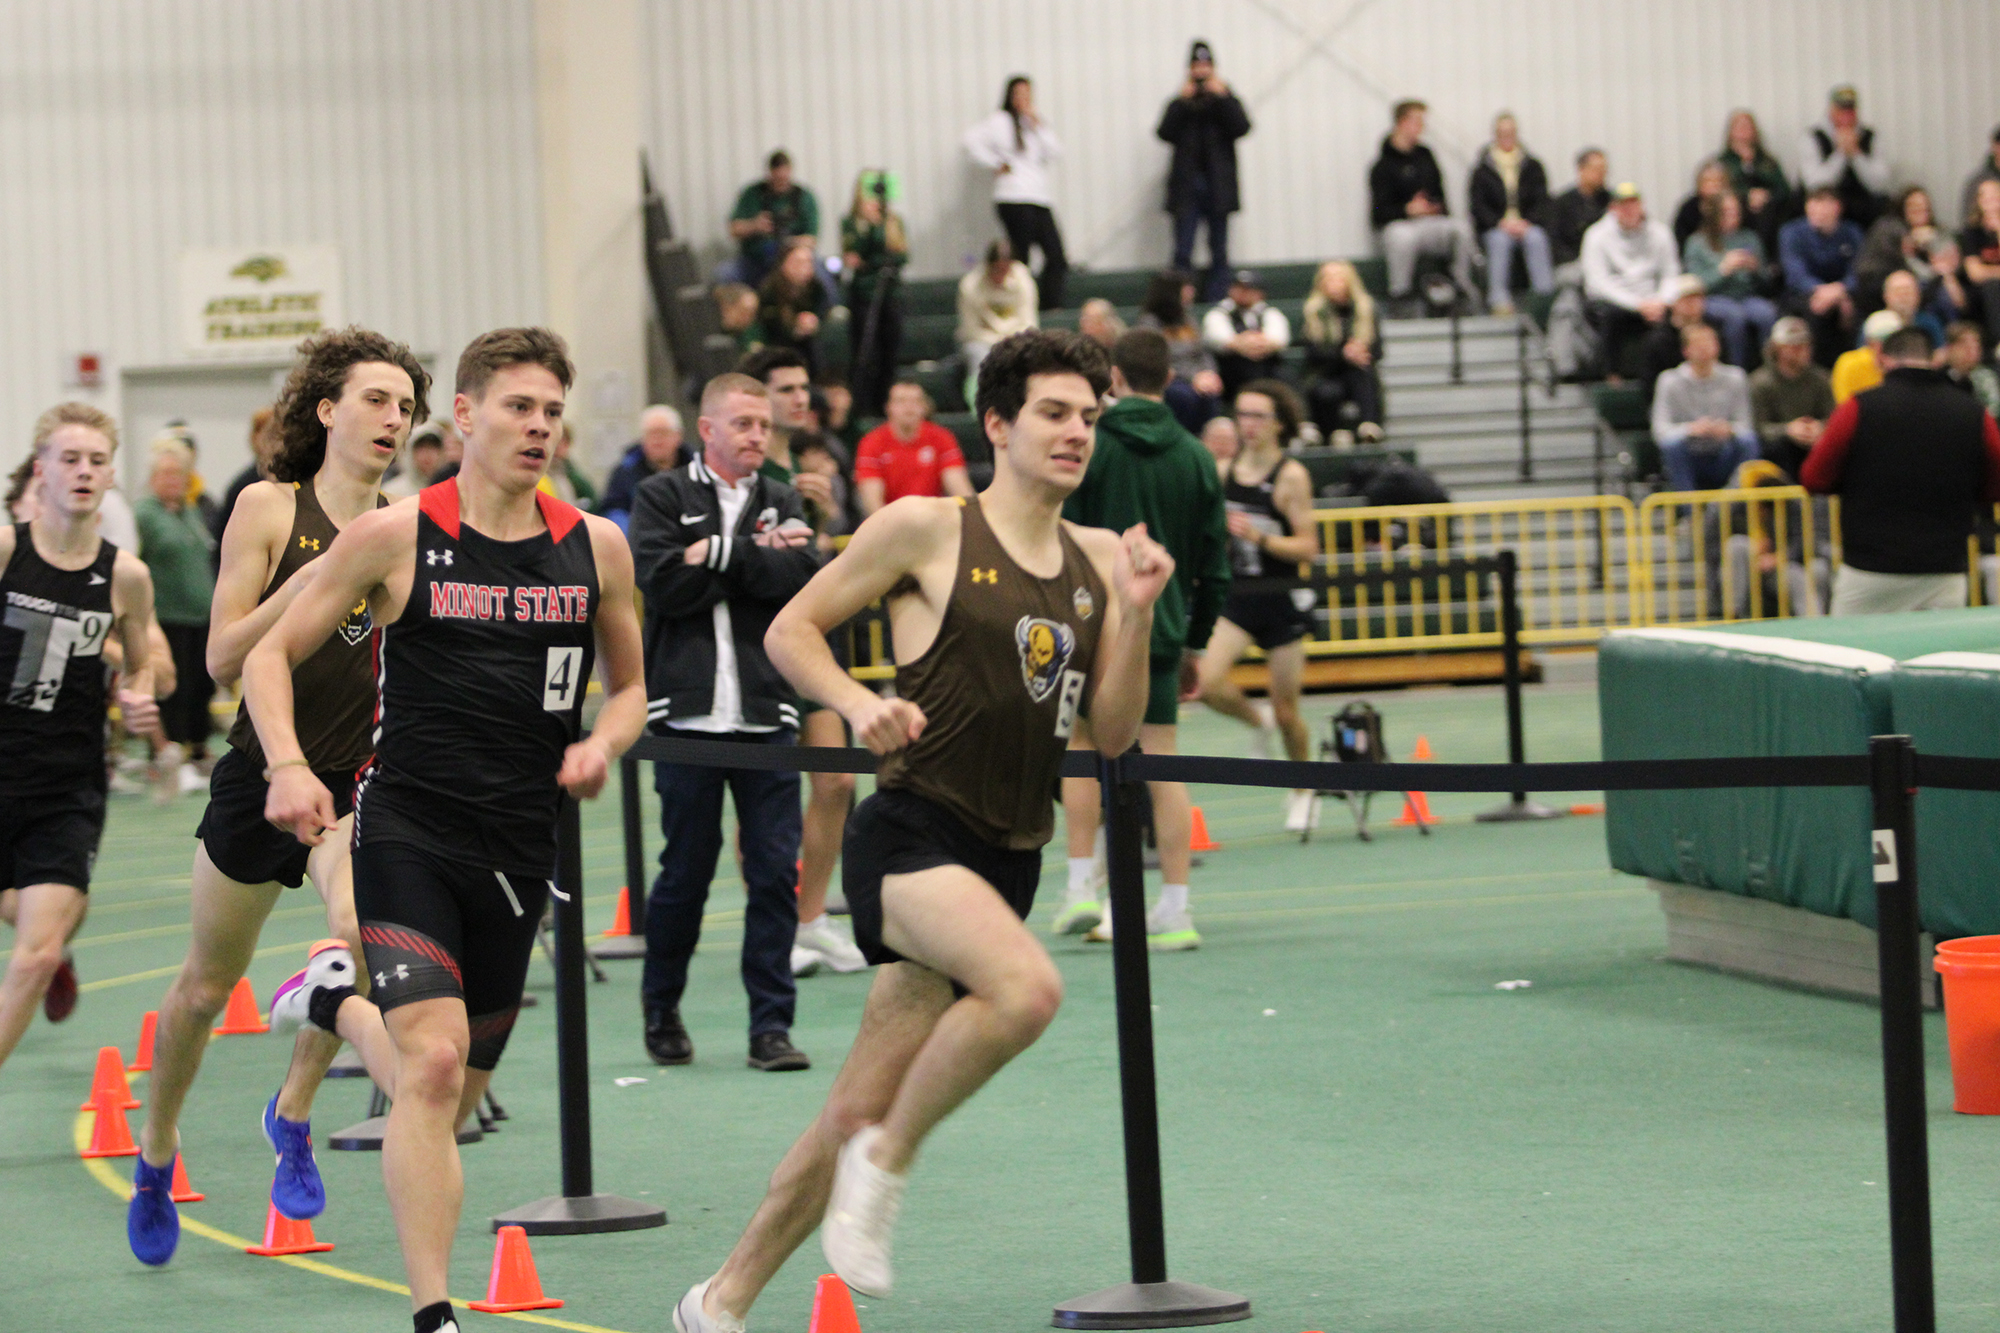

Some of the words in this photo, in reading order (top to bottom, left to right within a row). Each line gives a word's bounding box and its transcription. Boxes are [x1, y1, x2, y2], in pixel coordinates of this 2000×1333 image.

[430, 581, 508, 620] MINOT
[514, 586, 588, 622] STATE
[79, 616, 101, 649] 9
[548, 652, 571, 701] 4
